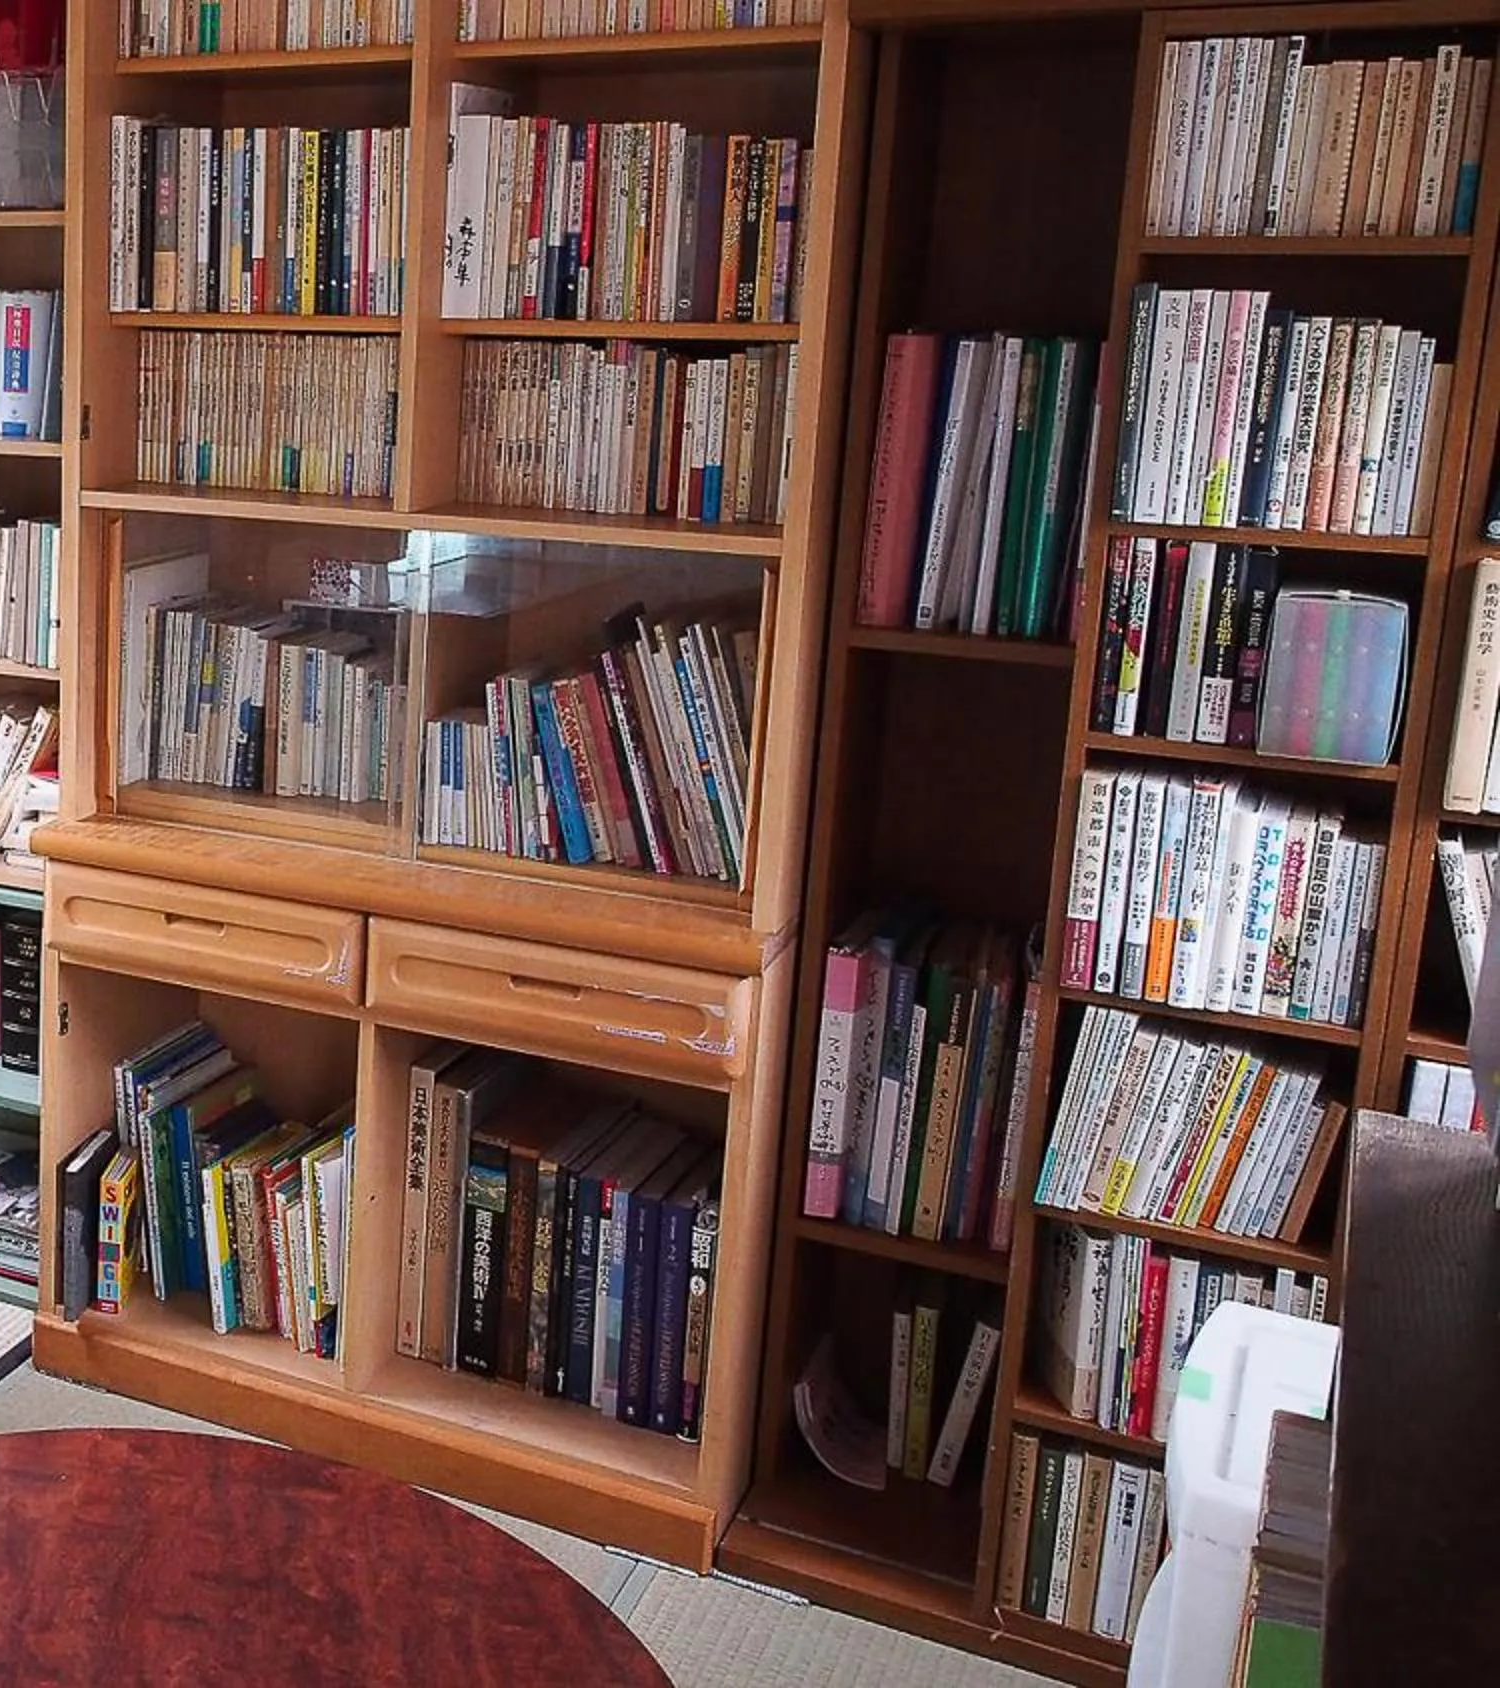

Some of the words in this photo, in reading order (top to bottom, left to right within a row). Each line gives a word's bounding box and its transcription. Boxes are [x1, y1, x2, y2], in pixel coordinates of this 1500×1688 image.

[408, 1087, 428, 1191] 日本美術全集
